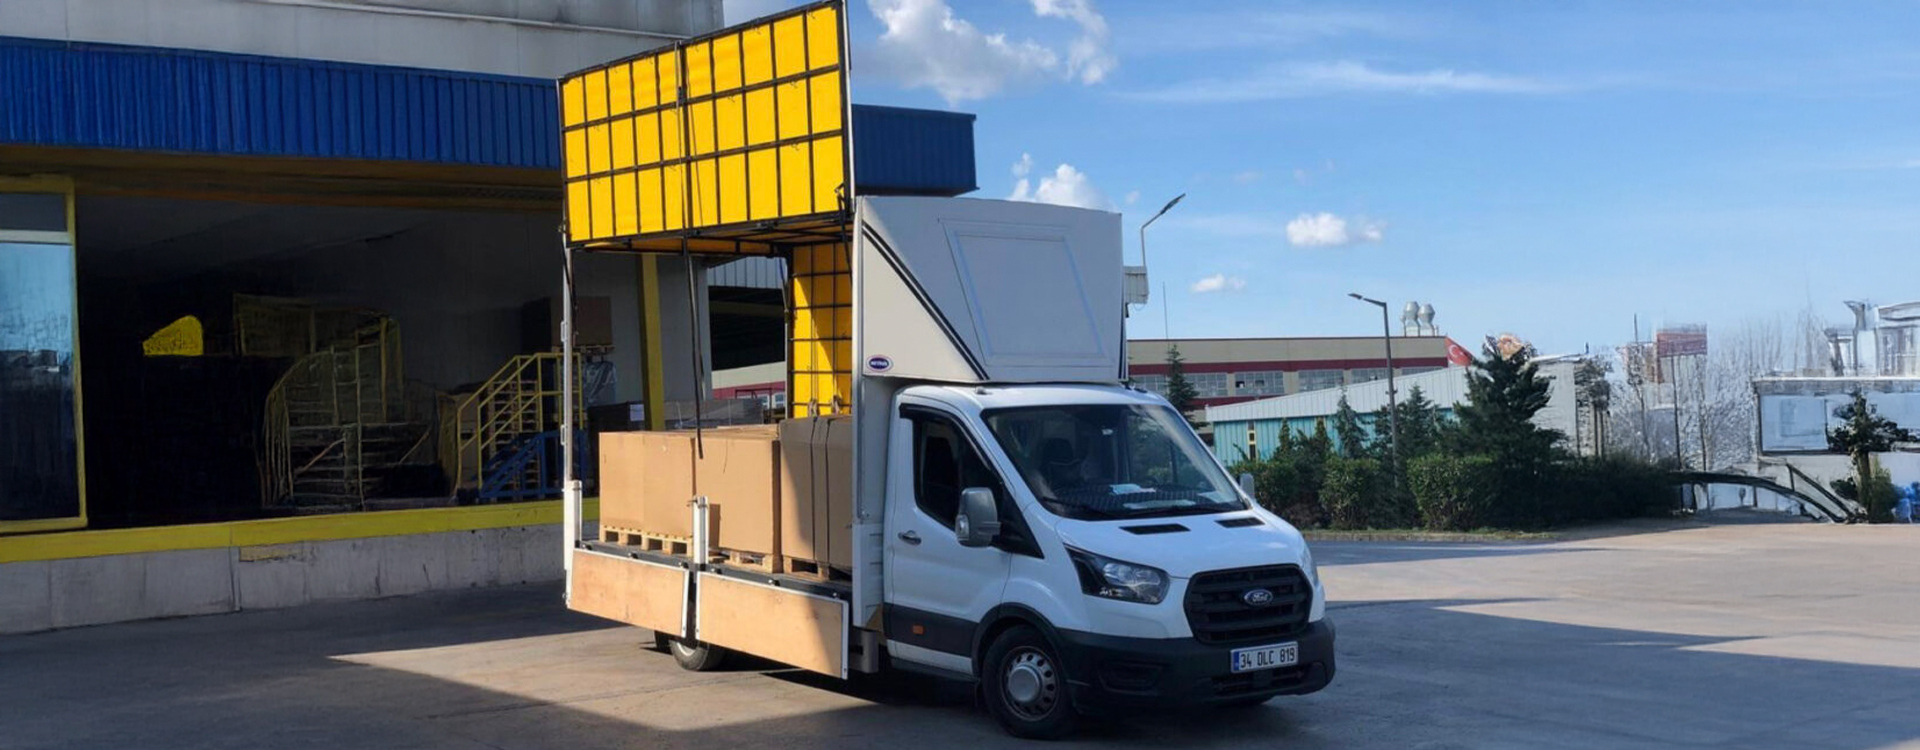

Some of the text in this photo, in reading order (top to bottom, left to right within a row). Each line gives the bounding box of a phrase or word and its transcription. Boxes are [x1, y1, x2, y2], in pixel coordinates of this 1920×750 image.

[1240, 647, 1295, 668] 34 DLC 819
